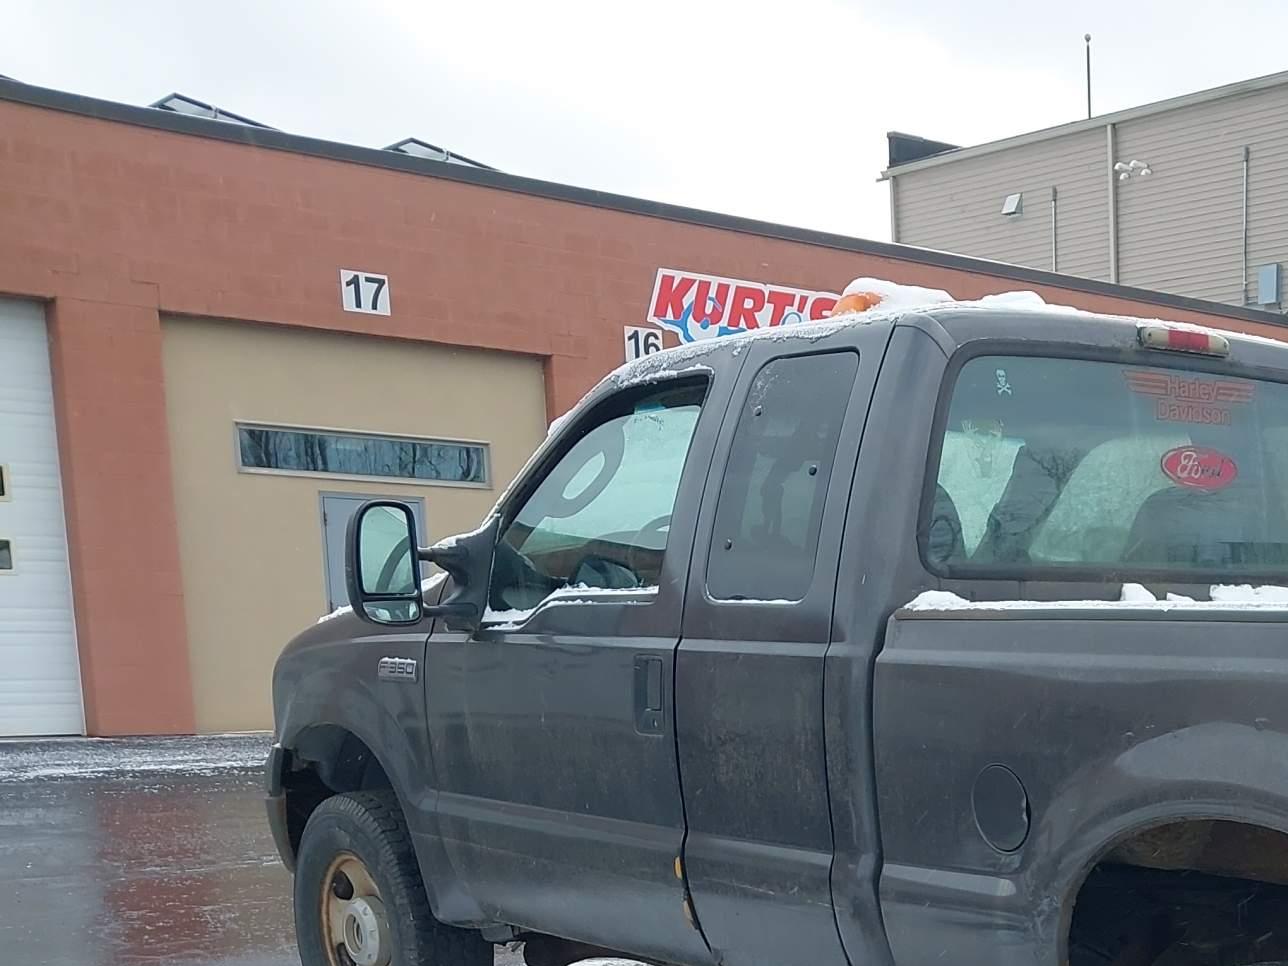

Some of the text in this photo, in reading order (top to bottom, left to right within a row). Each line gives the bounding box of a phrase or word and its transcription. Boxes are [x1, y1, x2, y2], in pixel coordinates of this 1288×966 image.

[345, 274, 386, 311] 17
[627, 329, 661, 359] 16
[1167, 375, 1217, 402] Harley
[1156, 399, 1232, 426] Davidson
[1176, 450, 1223, 480] Ford
